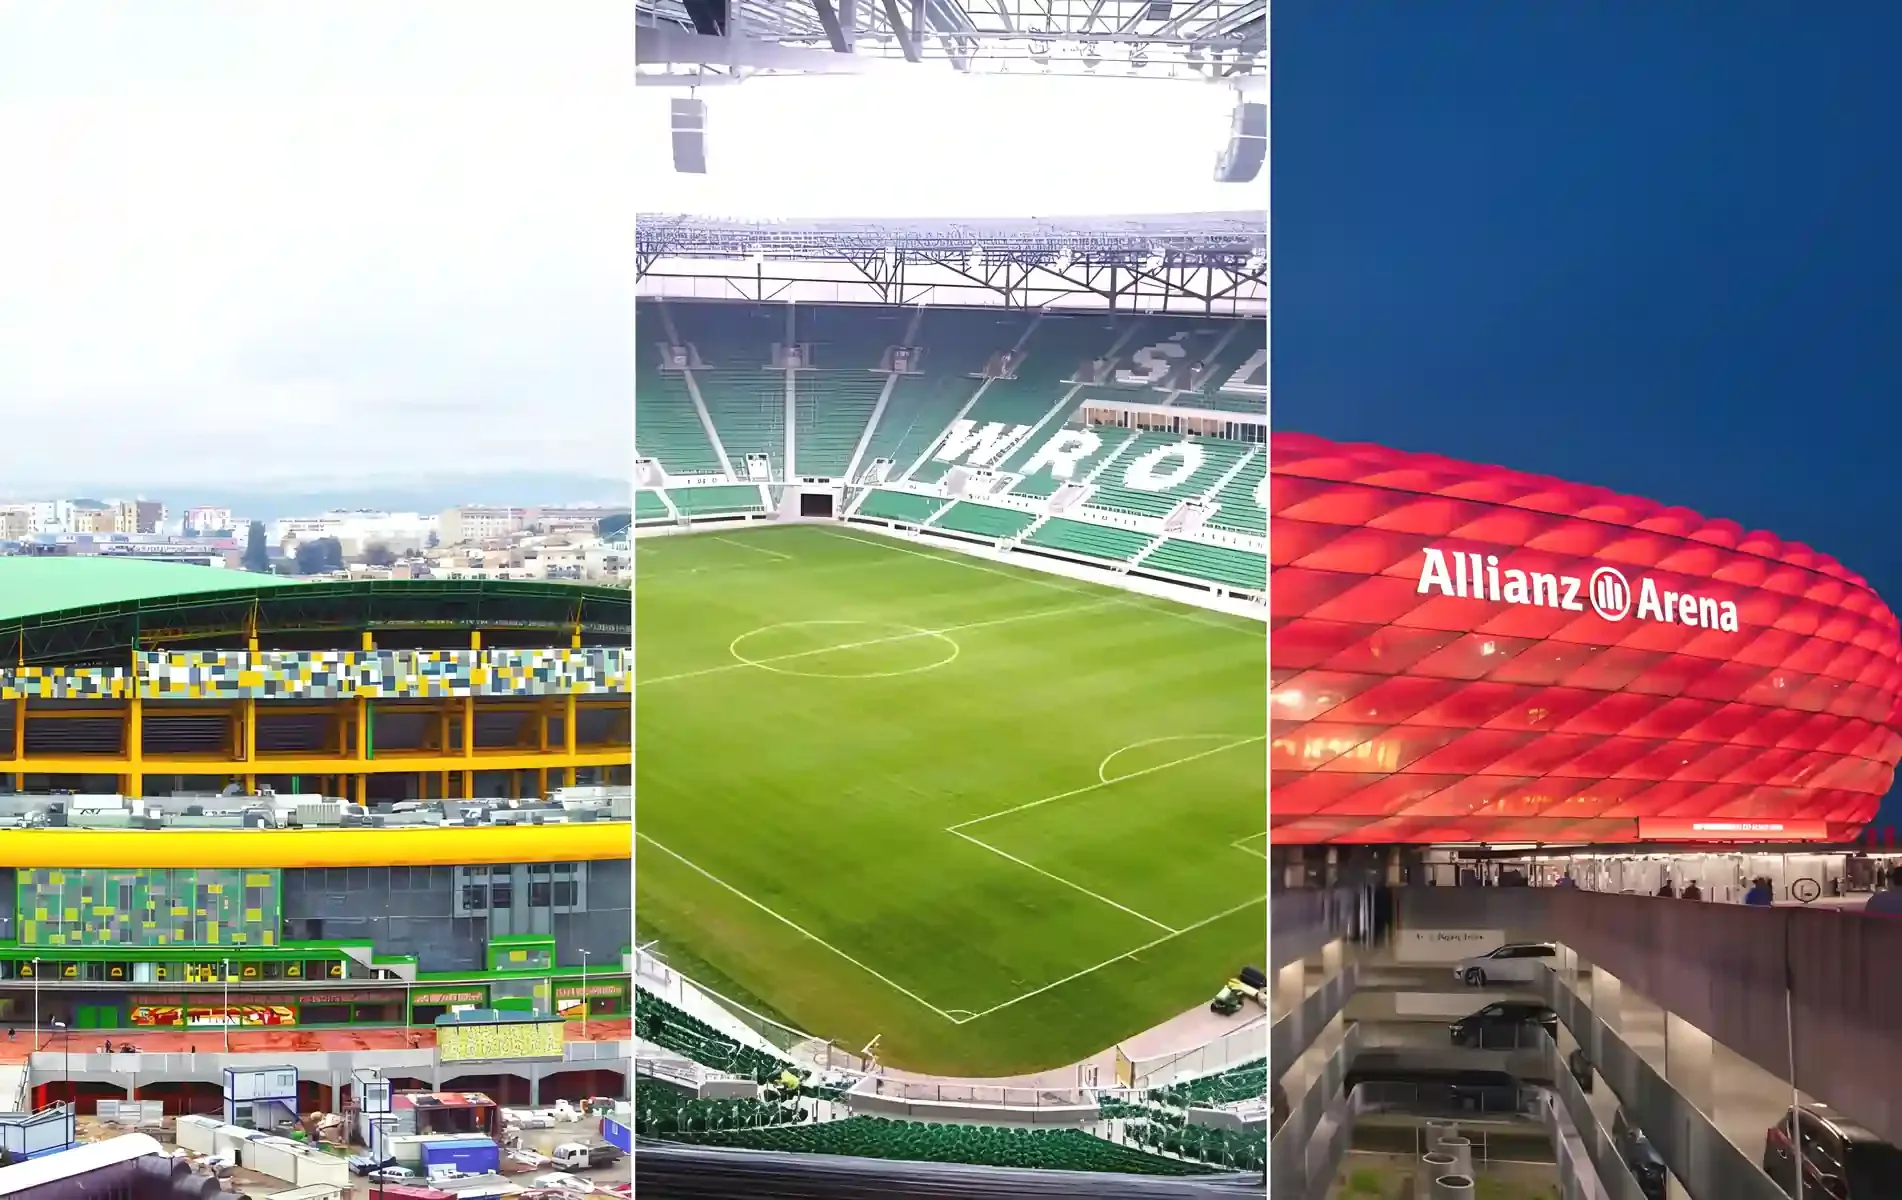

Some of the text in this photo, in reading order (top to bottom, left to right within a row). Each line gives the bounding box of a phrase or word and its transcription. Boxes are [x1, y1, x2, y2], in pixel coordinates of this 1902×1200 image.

[932, 419, 1267, 507] WRO
[1418, 548, 1738, 632] Allianz Arena
